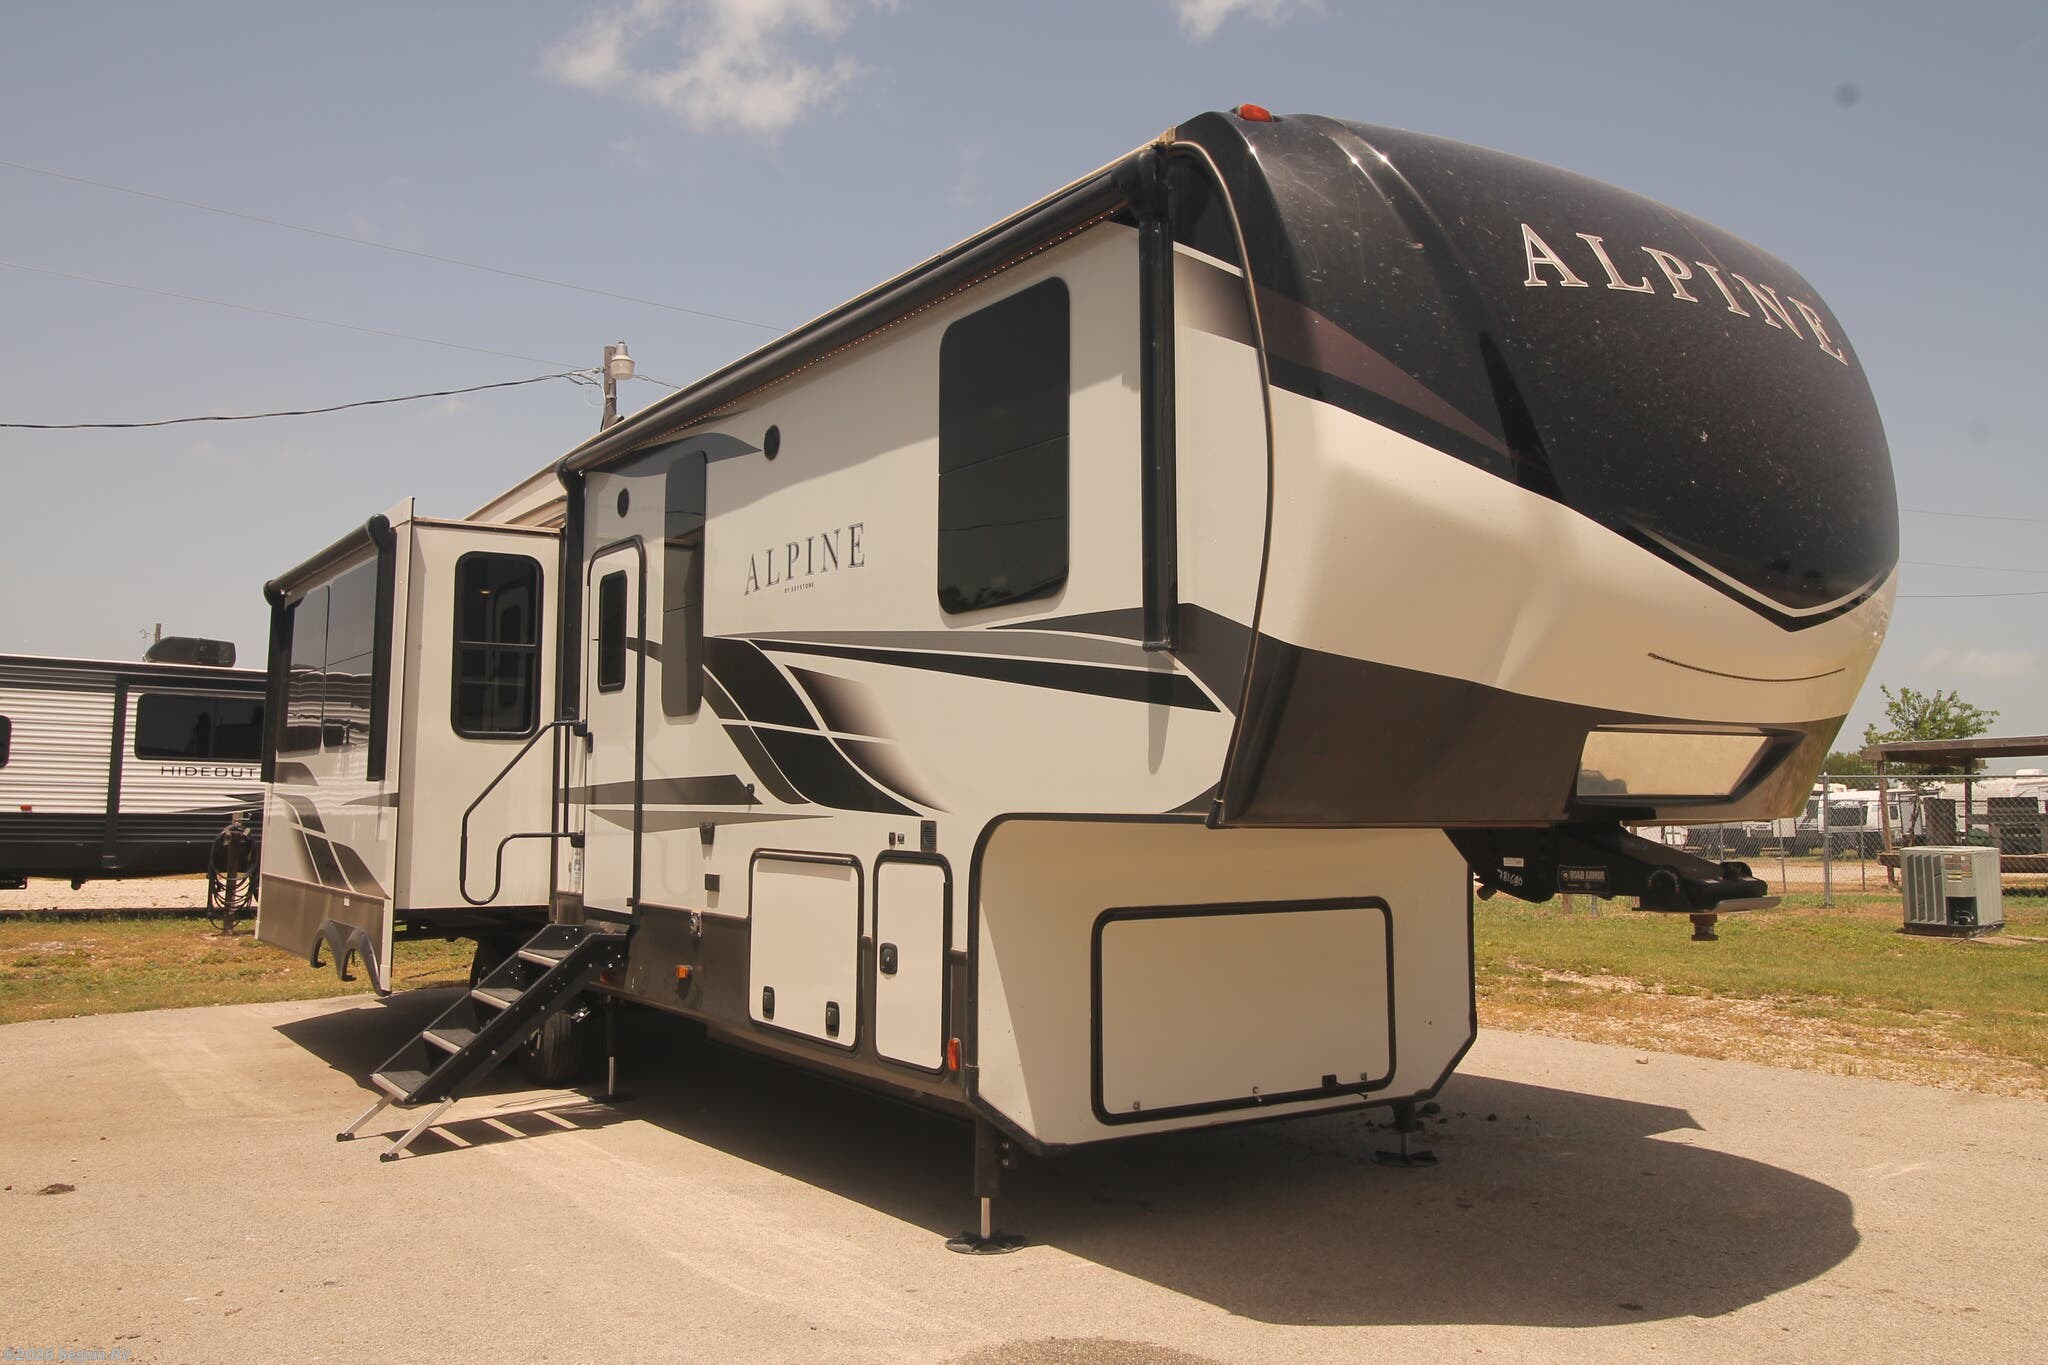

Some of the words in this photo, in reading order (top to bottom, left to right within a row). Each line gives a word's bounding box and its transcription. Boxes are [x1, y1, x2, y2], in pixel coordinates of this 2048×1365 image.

[1520, 223, 1848, 366] ALPINE
[744, 522, 865, 596] ALPINE
[160, 766, 257, 777] HIDEOUT
